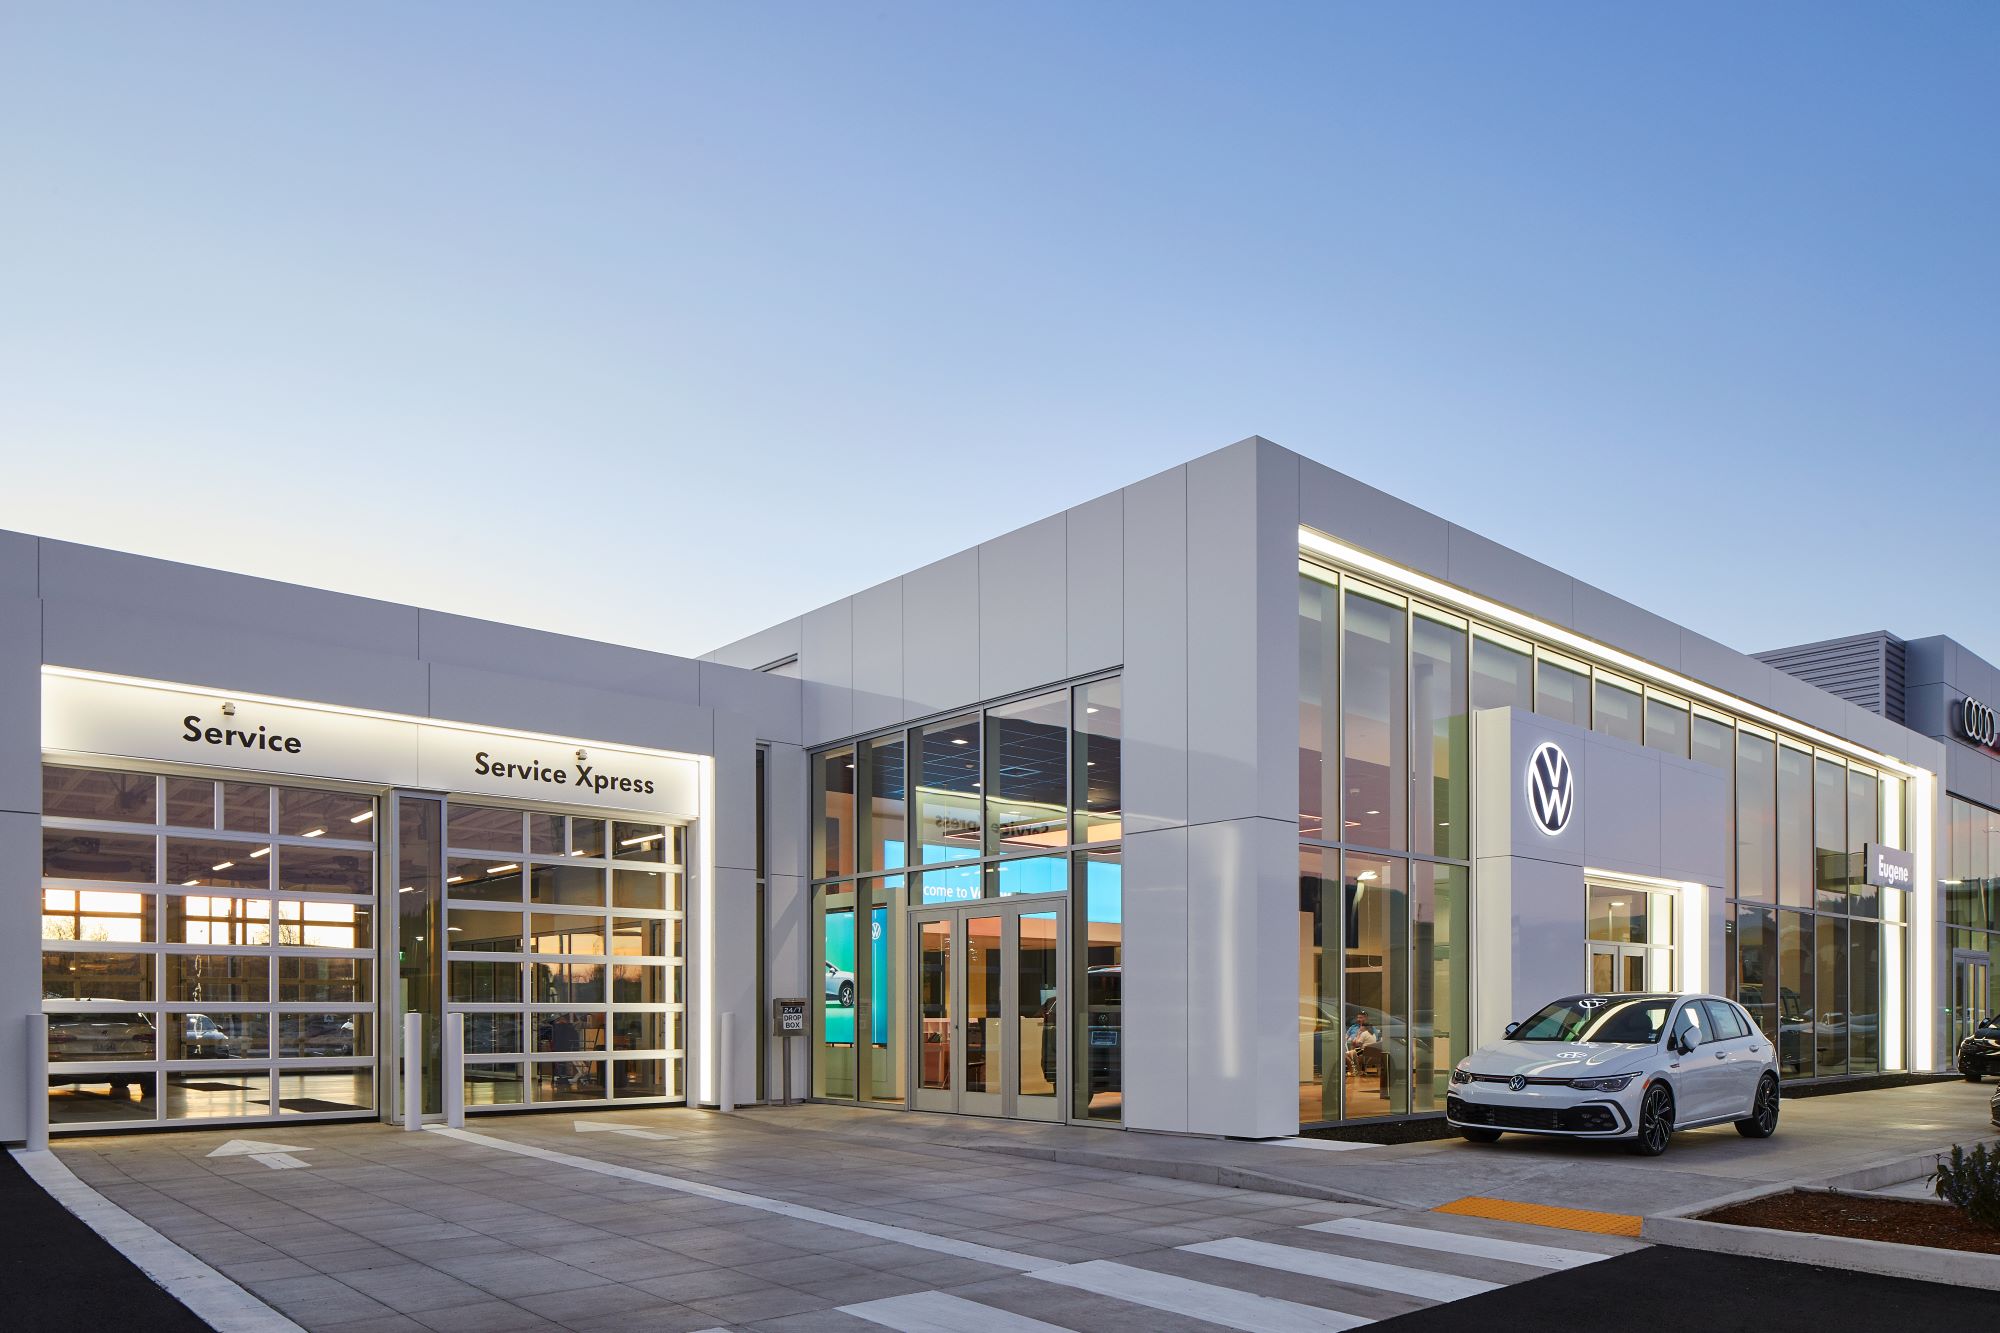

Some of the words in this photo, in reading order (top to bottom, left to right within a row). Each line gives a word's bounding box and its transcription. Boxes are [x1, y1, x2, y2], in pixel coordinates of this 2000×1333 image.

[183, 715, 301, 754] Service
[475, 751, 567, 784] Service
[575, 764, 654, 794] Xpress
[1878, 854, 1909, 885] Eugene
[924, 885, 953, 898] come
[956, 886, 967, 898] to
